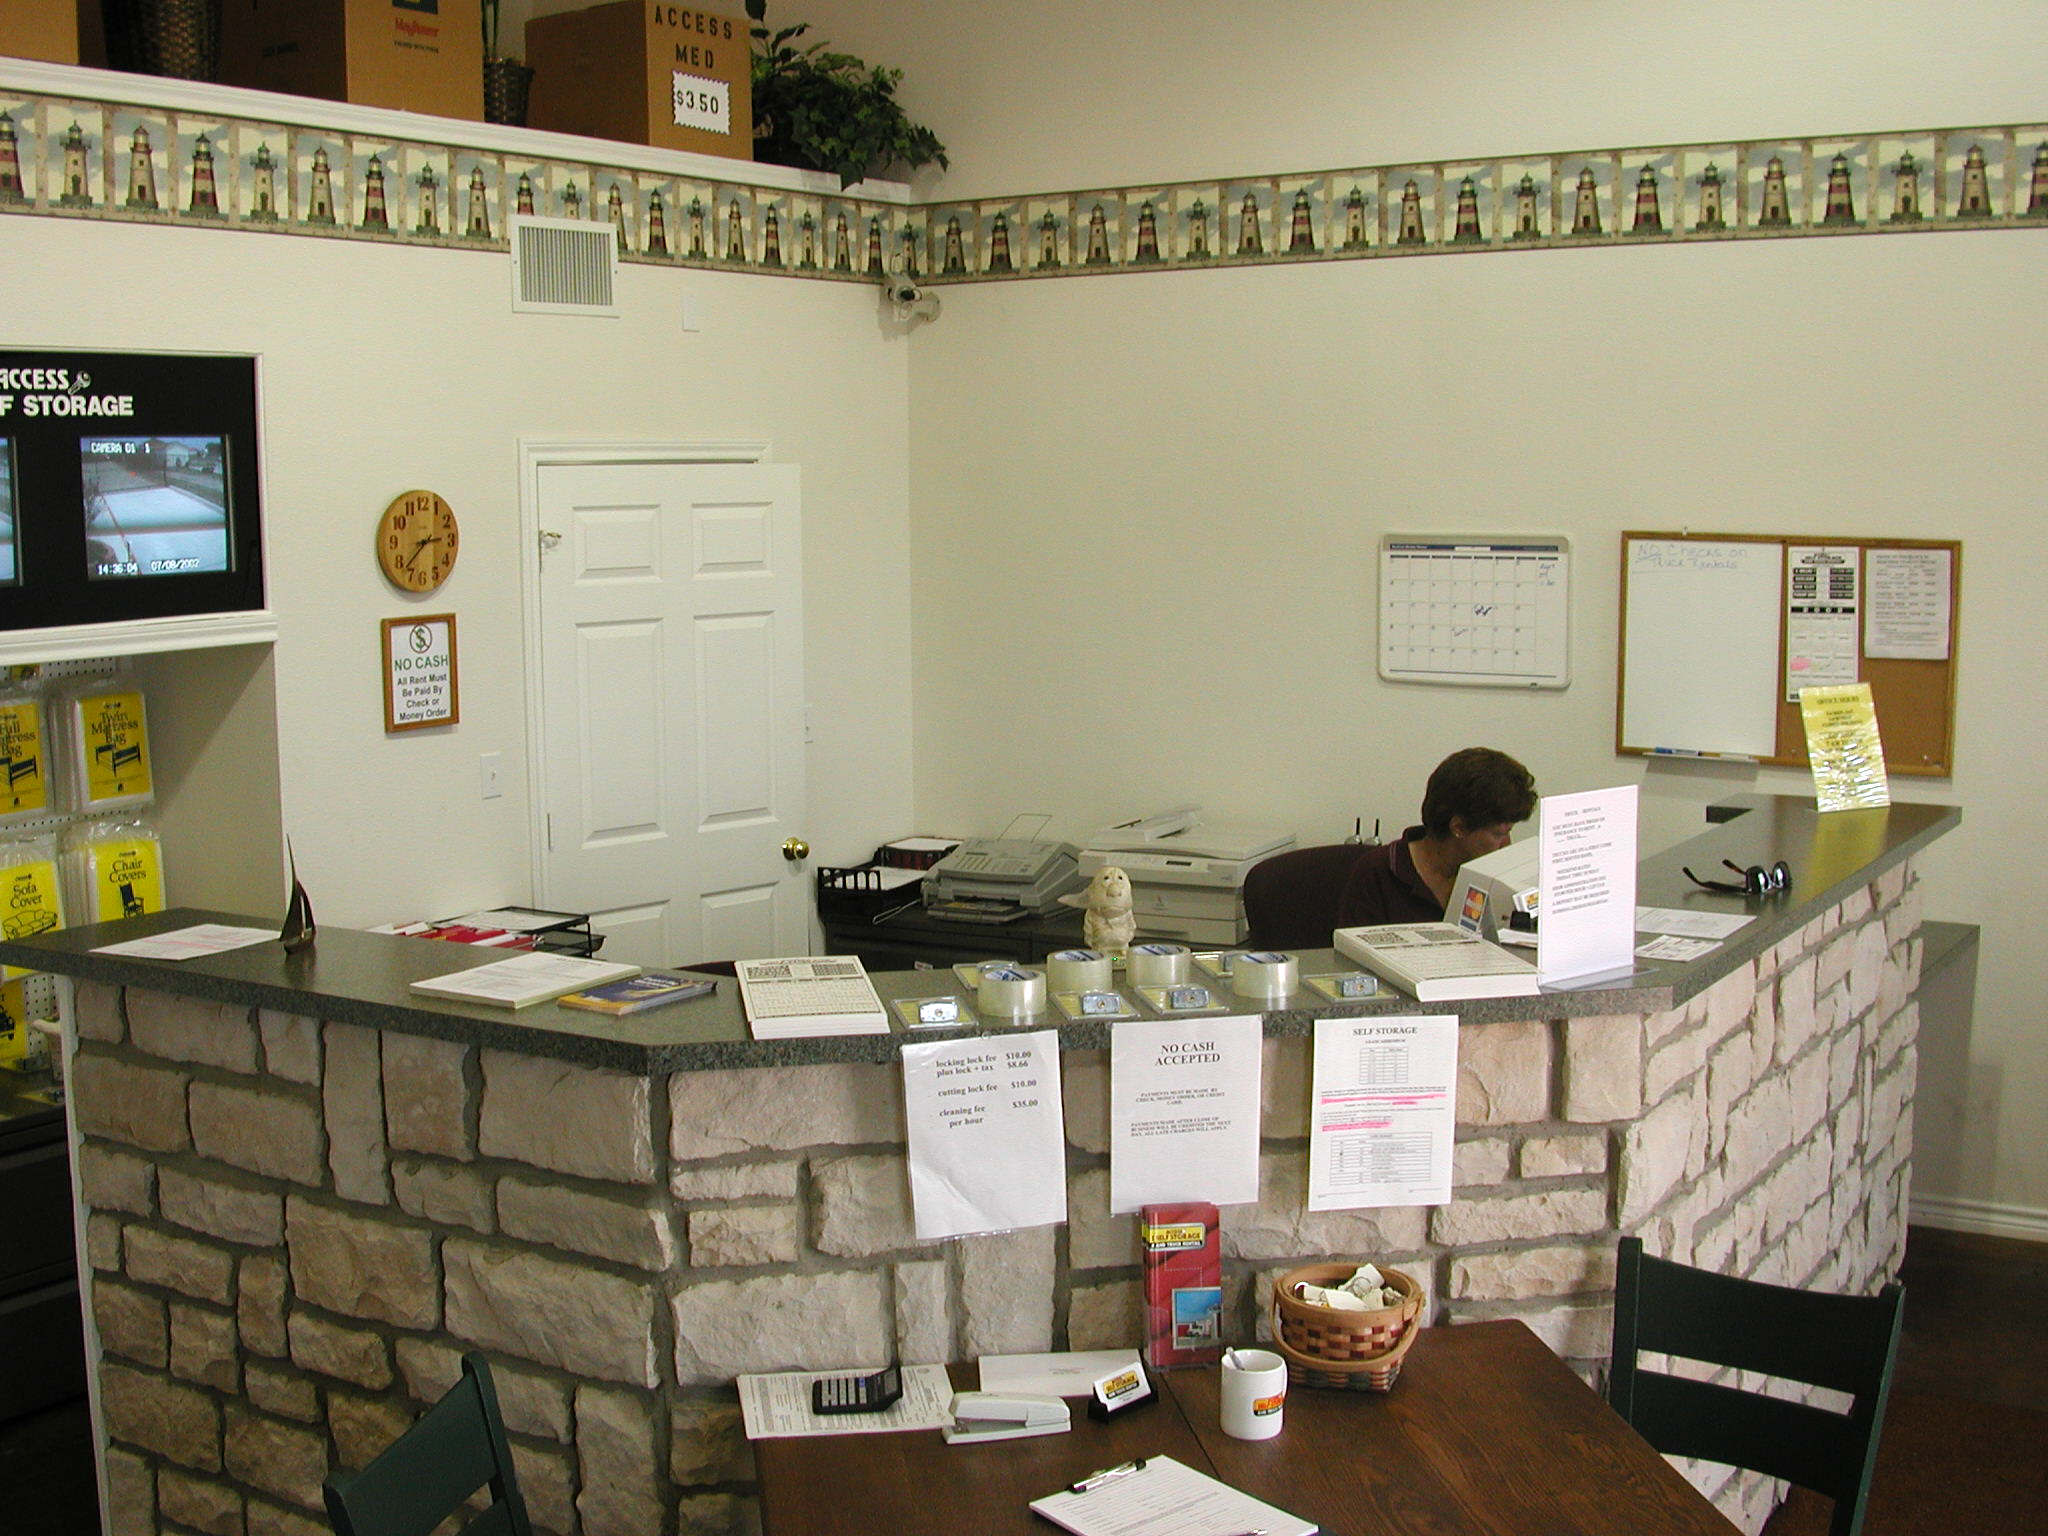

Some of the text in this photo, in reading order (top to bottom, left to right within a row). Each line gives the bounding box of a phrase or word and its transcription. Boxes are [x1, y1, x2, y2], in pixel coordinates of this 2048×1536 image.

[654, 5, 733, 40] ACCESS
[675, 43, 714, 69] MED
[23, 394, 134, 417] STORAGE
[91, 442, 123, 453] CAMERA
[405, 501, 415, 516] 11
[417, 496, 429, 511] 12
[393, 514, 407, 531] 10
[442, 513, 451, 529] 2
[389, 534, 399, 550] 9
[447, 532, 455, 548] 3
[395, 554, 404, 569] 8
[441, 552, 450, 568] 4
[407, 567, 415, 582] 7
[417, 571, 427, 585] 6
[431, 565, 440, 580] 5
[394, 654, 448, 672] NO CASH
[397, 673, 448, 686] All Rent Must
[402, 685, 443, 697] Be Paid By
[406, 698, 429, 709] Check
[399, 708, 448, 721] Money Order
[112, 858, 142, 873] Chair
[109, 870, 147, 883] Covers
[13, 881, 38, 896] Sofa
[10, 894, 42, 909] Cover
[1352, 1026, 1418, 1037] SELF STORAGE
[1160, 1041, 1214, 1055] NO CASH
[936, 1058, 965, 1069] locking
[967, 1056, 983, 1064] lock
[1155, 1053, 1221, 1066] ACCEPTED
[936, 1069, 953, 1078] plus
[955, 1066, 971, 1075] lock
[938, 1080, 1037, 1097] cutting lock fee $10.00
[939, 1107, 972, 1117] cleaning
[974, 1105, 986, 1113] fee
[949, 1117, 983, 1128] per hour
